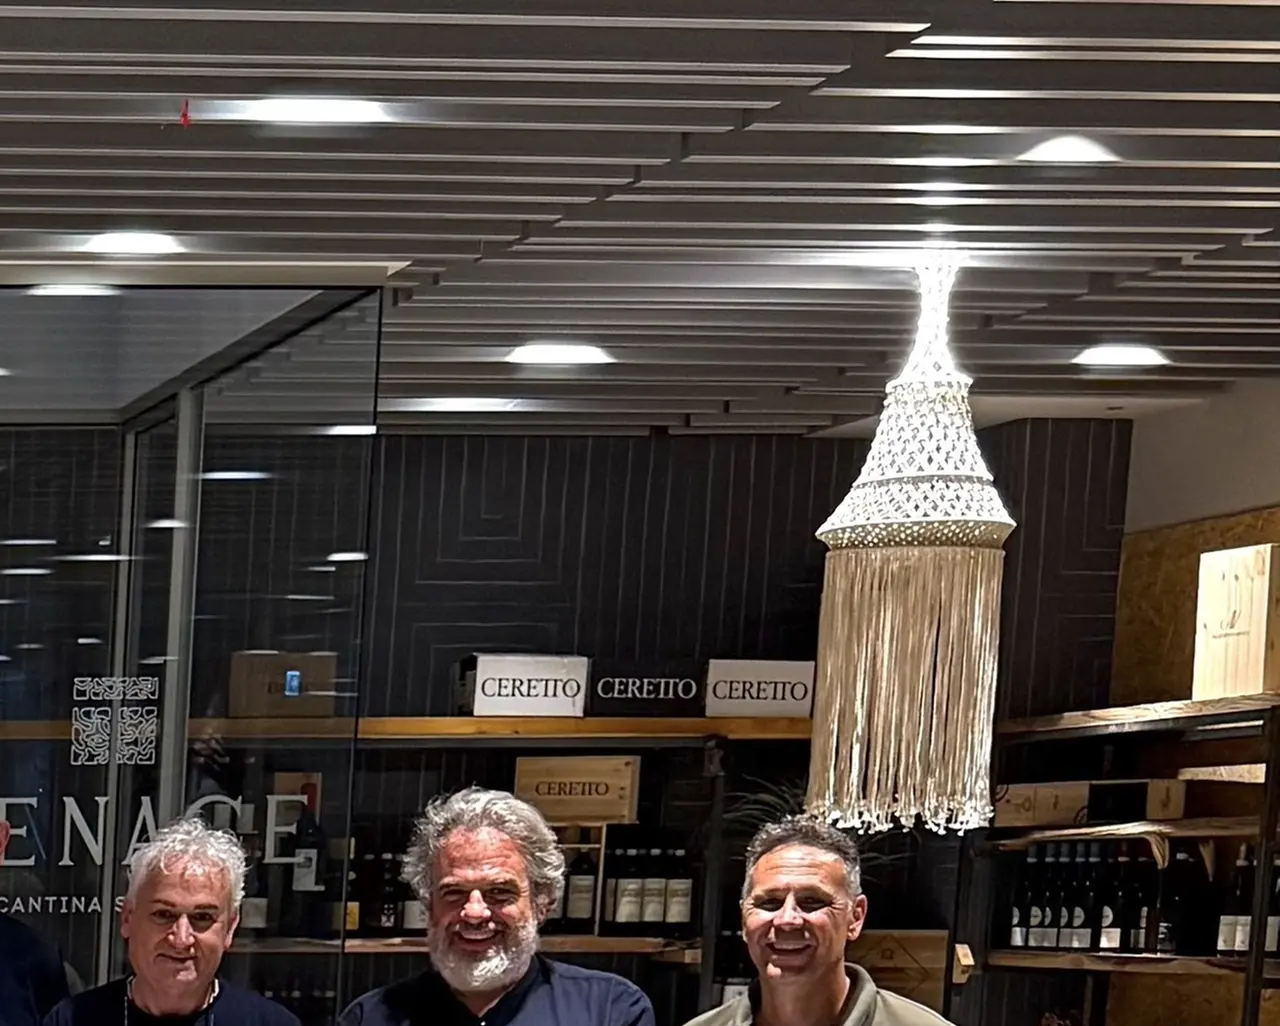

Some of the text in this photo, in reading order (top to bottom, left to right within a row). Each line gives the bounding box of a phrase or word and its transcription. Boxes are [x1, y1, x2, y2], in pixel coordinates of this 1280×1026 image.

[481, 678, 581, 699] CERETTO
[596, 677, 698, 699] CERETTO
[711, 679, 809, 701] CERETTO
[534, 781, 609, 797] CERETTO
